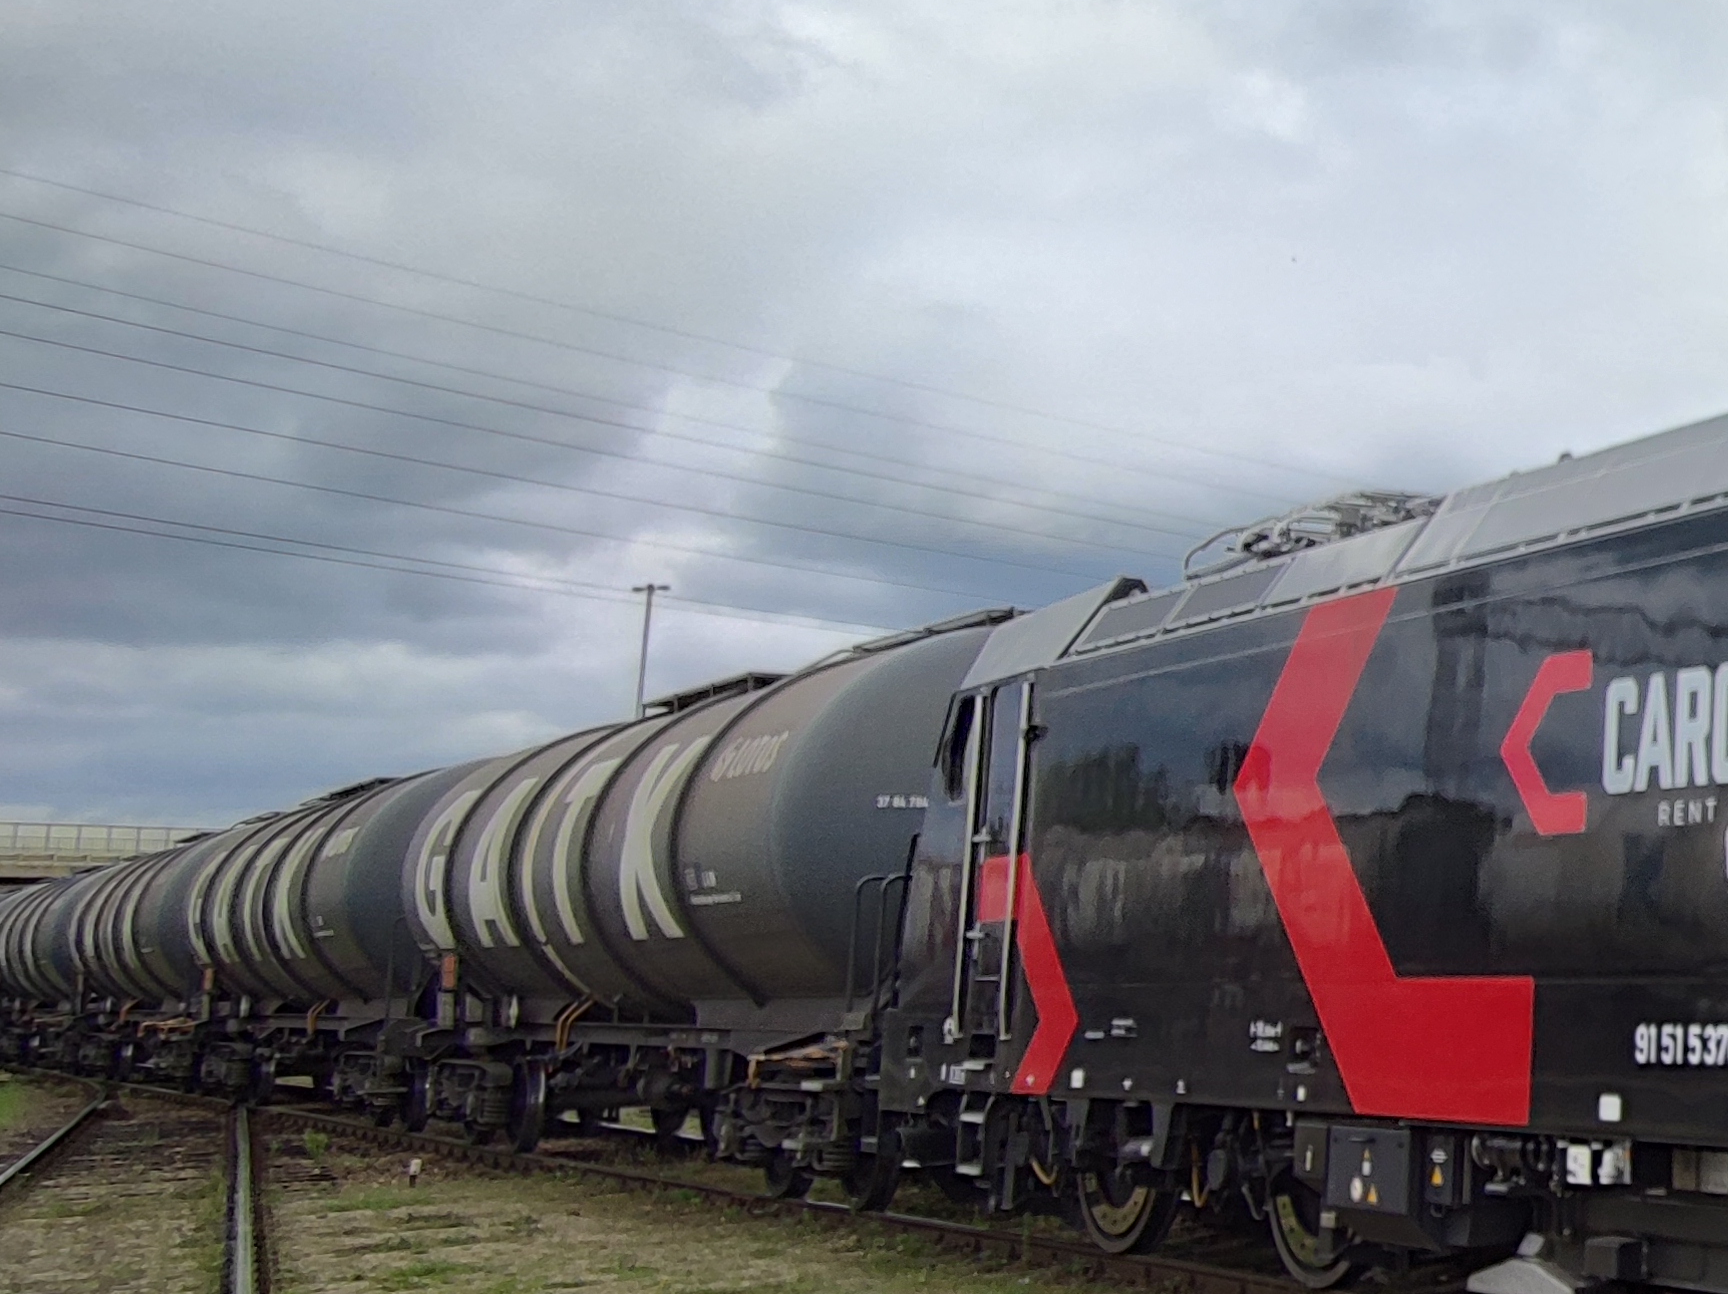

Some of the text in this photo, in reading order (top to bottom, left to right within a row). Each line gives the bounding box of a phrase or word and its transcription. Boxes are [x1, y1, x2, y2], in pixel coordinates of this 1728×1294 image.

[1656, 798, 1718, 827] RENT
[1634, 1023, 1657, 1066] 91
[1660, 1024, 1684, 1066] 51
